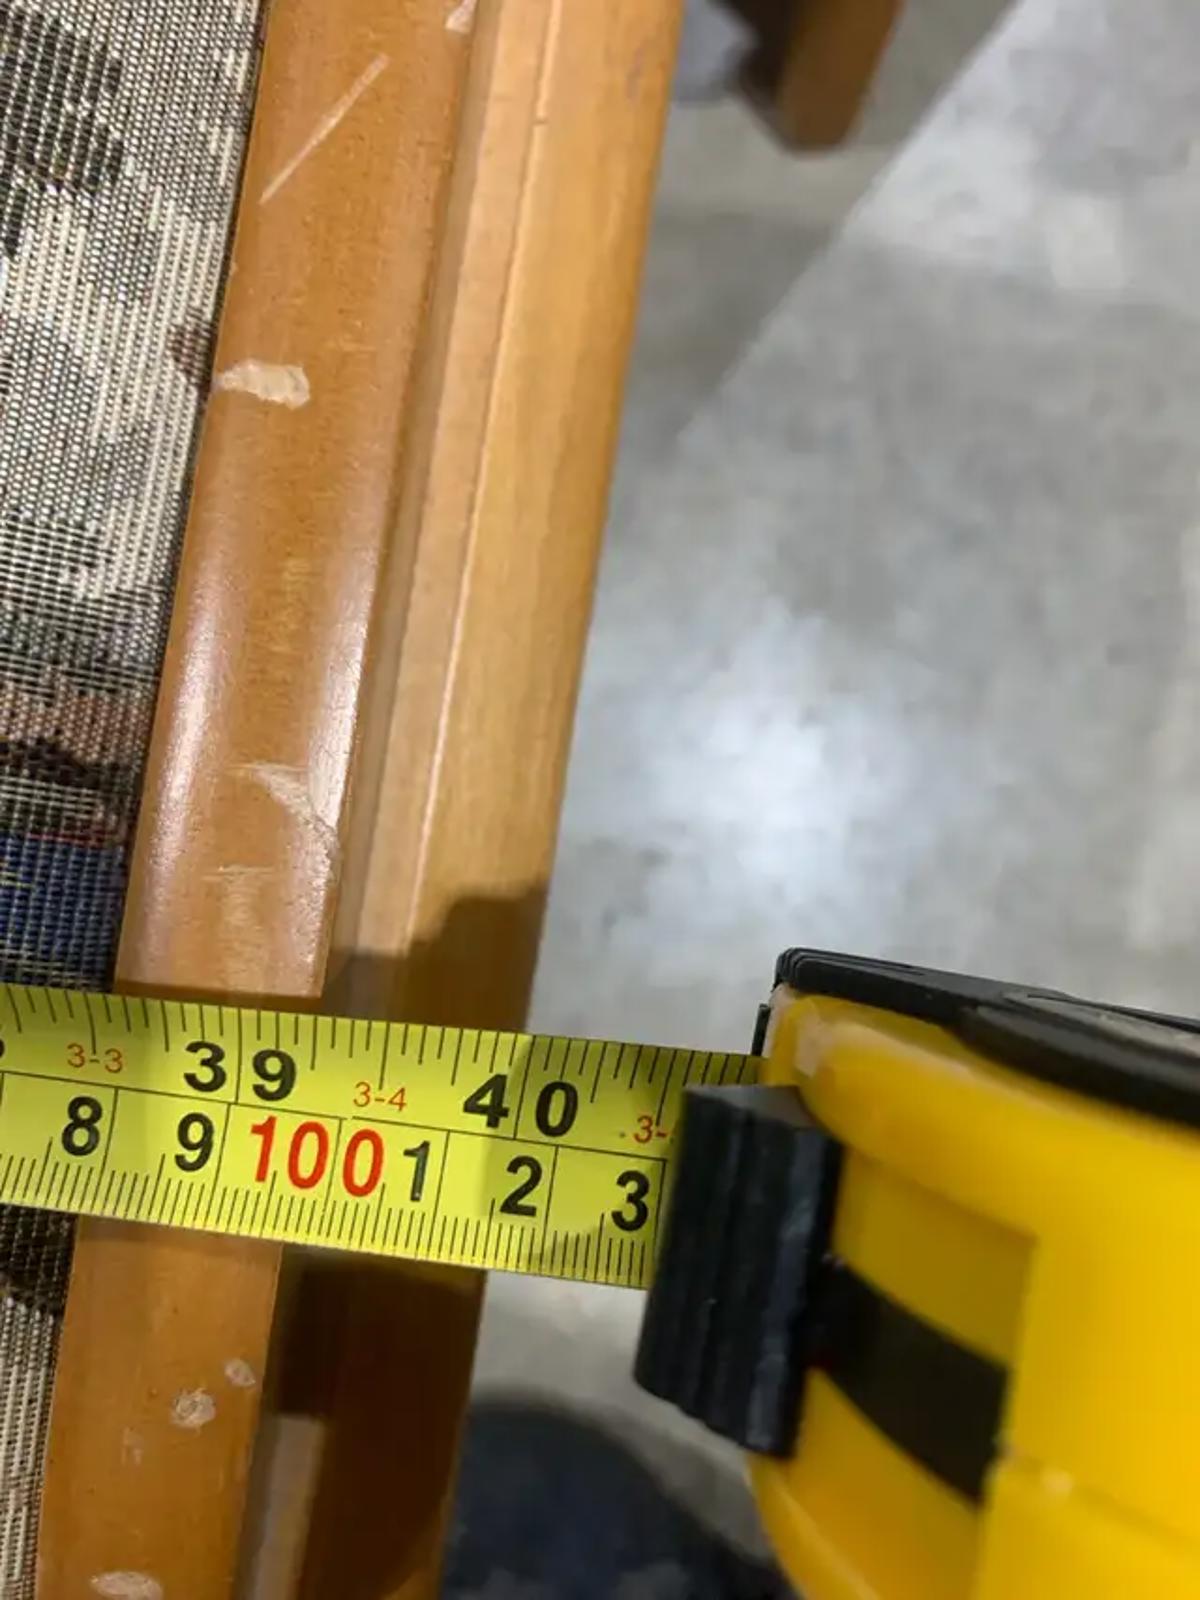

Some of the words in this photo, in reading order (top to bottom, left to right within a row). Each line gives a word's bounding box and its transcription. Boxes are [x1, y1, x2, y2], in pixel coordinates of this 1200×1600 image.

[66, 1042, 124, 1074] 3-3
[183, 1040, 297, 1102] 39
[353, 1081, 408, 1112] 3-4
[463, 1073, 579, 1138] 40
[633, 1115, 674, 1145] 3-
[61, 1096, 103, 1157] 8
[174, 1112, 215, 1172] 9
[250, 1115, 385, 1198] 100
[403, 1140, 431, 1202] 1
[500, 1155, 543, 1218] 2
[611, 1170, 650, 1232] 3
